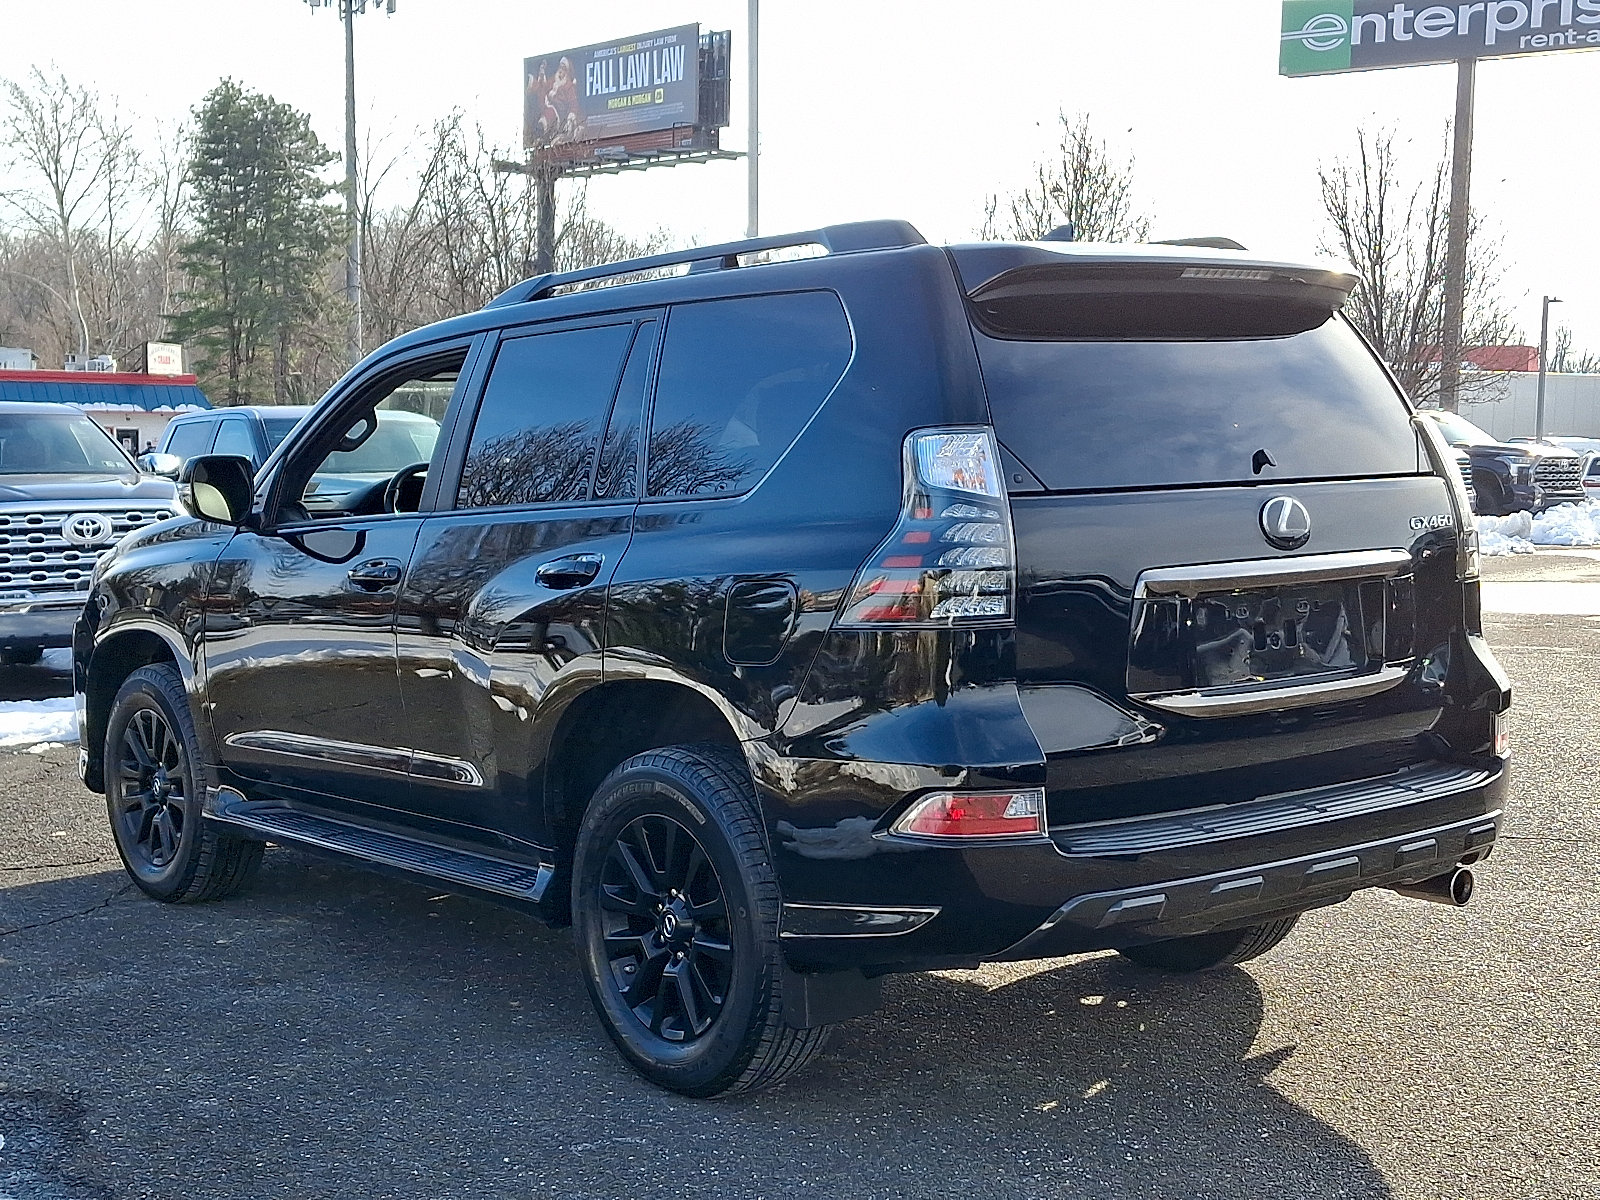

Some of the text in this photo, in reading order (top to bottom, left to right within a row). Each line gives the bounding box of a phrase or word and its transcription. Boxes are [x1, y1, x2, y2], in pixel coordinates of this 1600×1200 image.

[594, 35, 677, 58] AMERICA'S LARGEST INJURY LAW FIRM
[1520, 28, 1600, 49] rent-a
[586, 45, 685, 97] FALL LAW LAW
[608, 96, 627, 110] MORGAN
[627, 95, 632, 106] &
[632, 92, 652, 105] MORGAN
[1410, 514, 1452, 530] GX460
